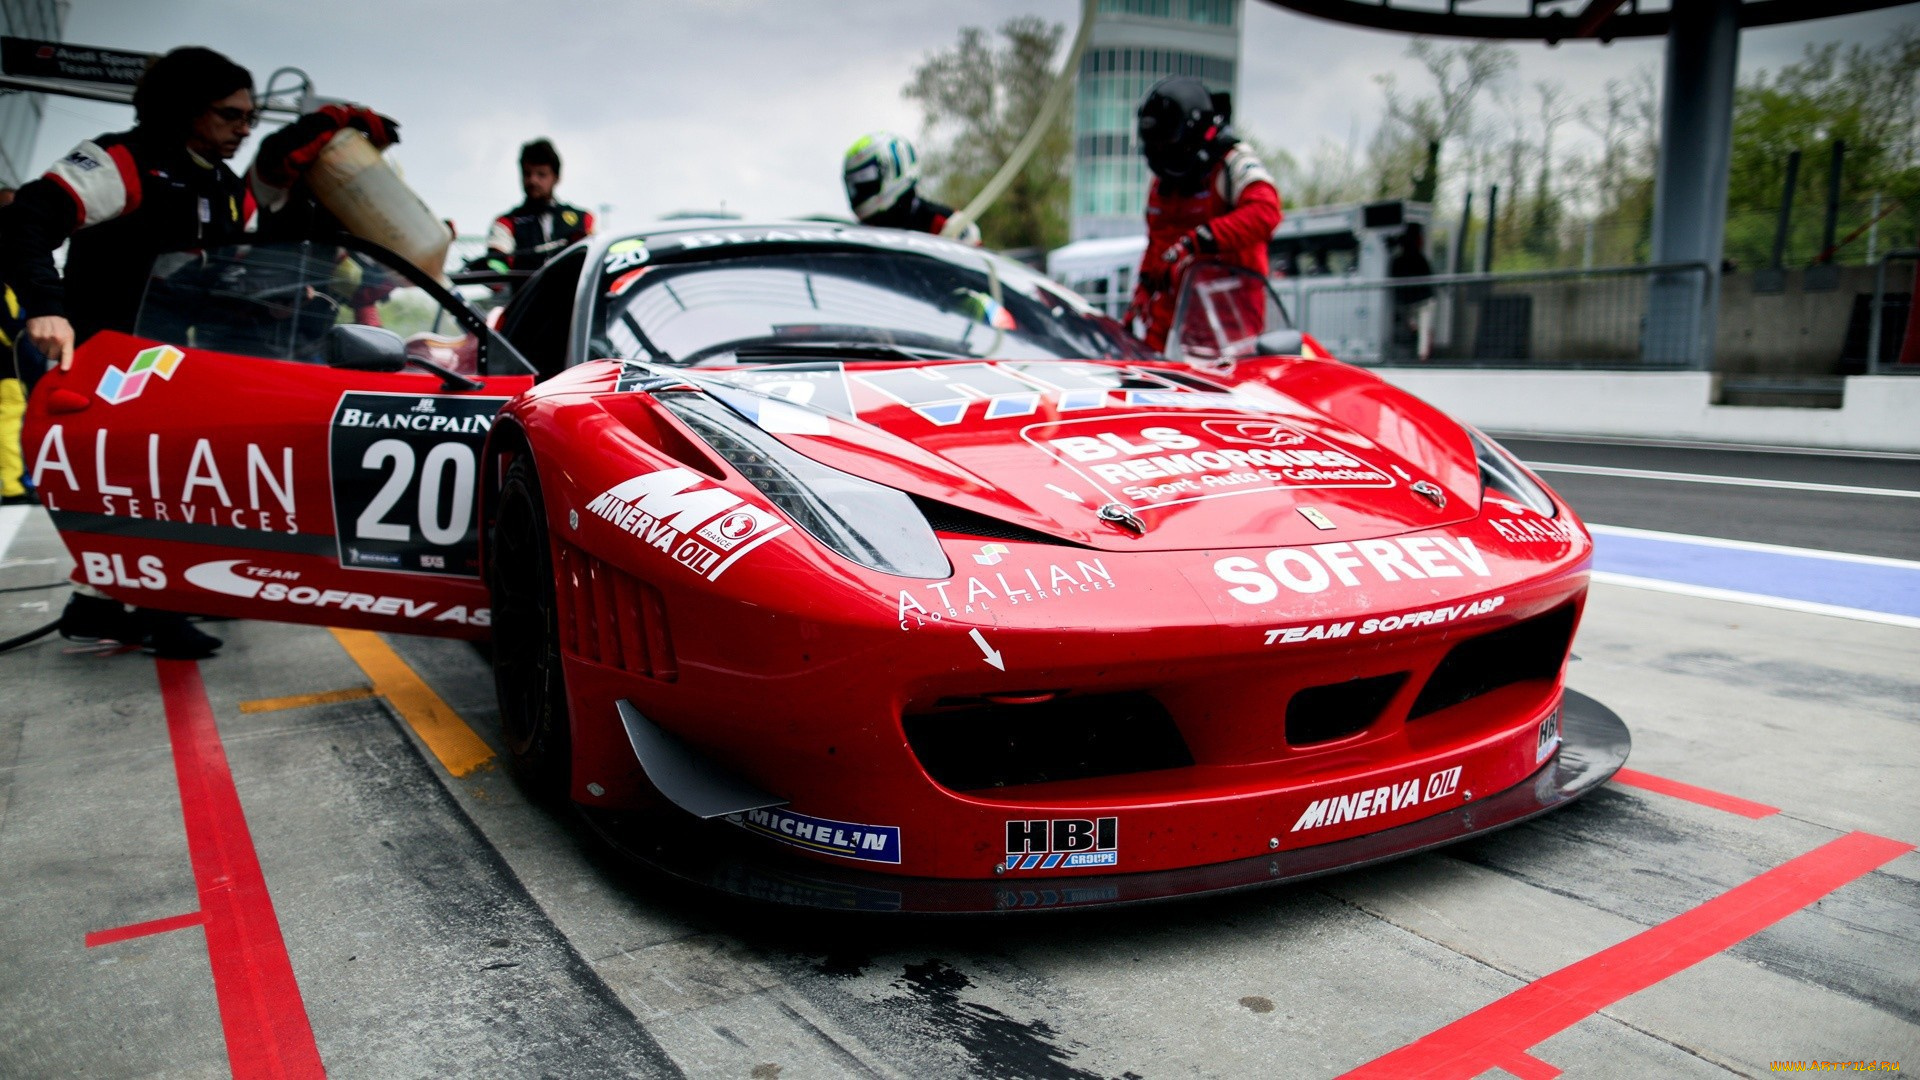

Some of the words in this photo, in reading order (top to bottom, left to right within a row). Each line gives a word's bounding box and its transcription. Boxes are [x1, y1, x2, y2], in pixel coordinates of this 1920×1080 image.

[604, 247, 651, 274] 20
[341, 408, 495, 434] BLANCPAIN
[1049, 427, 1200, 463] BLS
[1090, 448, 1361, 485] REMORQUES
[1122, 478, 1200, 502] Sport
[1202, 469, 1261, 489] Auto
[1259, 468, 1283, 481] &
[1284, 466, 1386, 482] Collection
[355, 438, 476, 546] 20
[103, 495, 299, 535] SERVICES
[585, 491, 679, 554] MINERVA
[676, 542, 713, 574] OIL
[700, 528, 732, 549] FRANCE
[81, 551, 168, 590] BLS
[246, 566, 301, 580] TEAM
[898, 557, 1111, 621] ATALIAN
[1213, 536, 1492, 605] SOFREV
[259, 582, 437, 618] SOFREV
[1009, 579, 1117, 605] SERVICES
[1263, 621, 1354, 645] TEAM
[1358, 604, 1466, 635] SOFREV
[1462, 596, 1505, 619] ASP
[1290, 778, 1421, 833] MINERVA
[1427, 766, 1461, 800] OIL
[749, 809, 888, 851] MICHELIN
[1006, 817, 1118, 854] HBI
[1070, 853, 1115, 865] GROUPE
